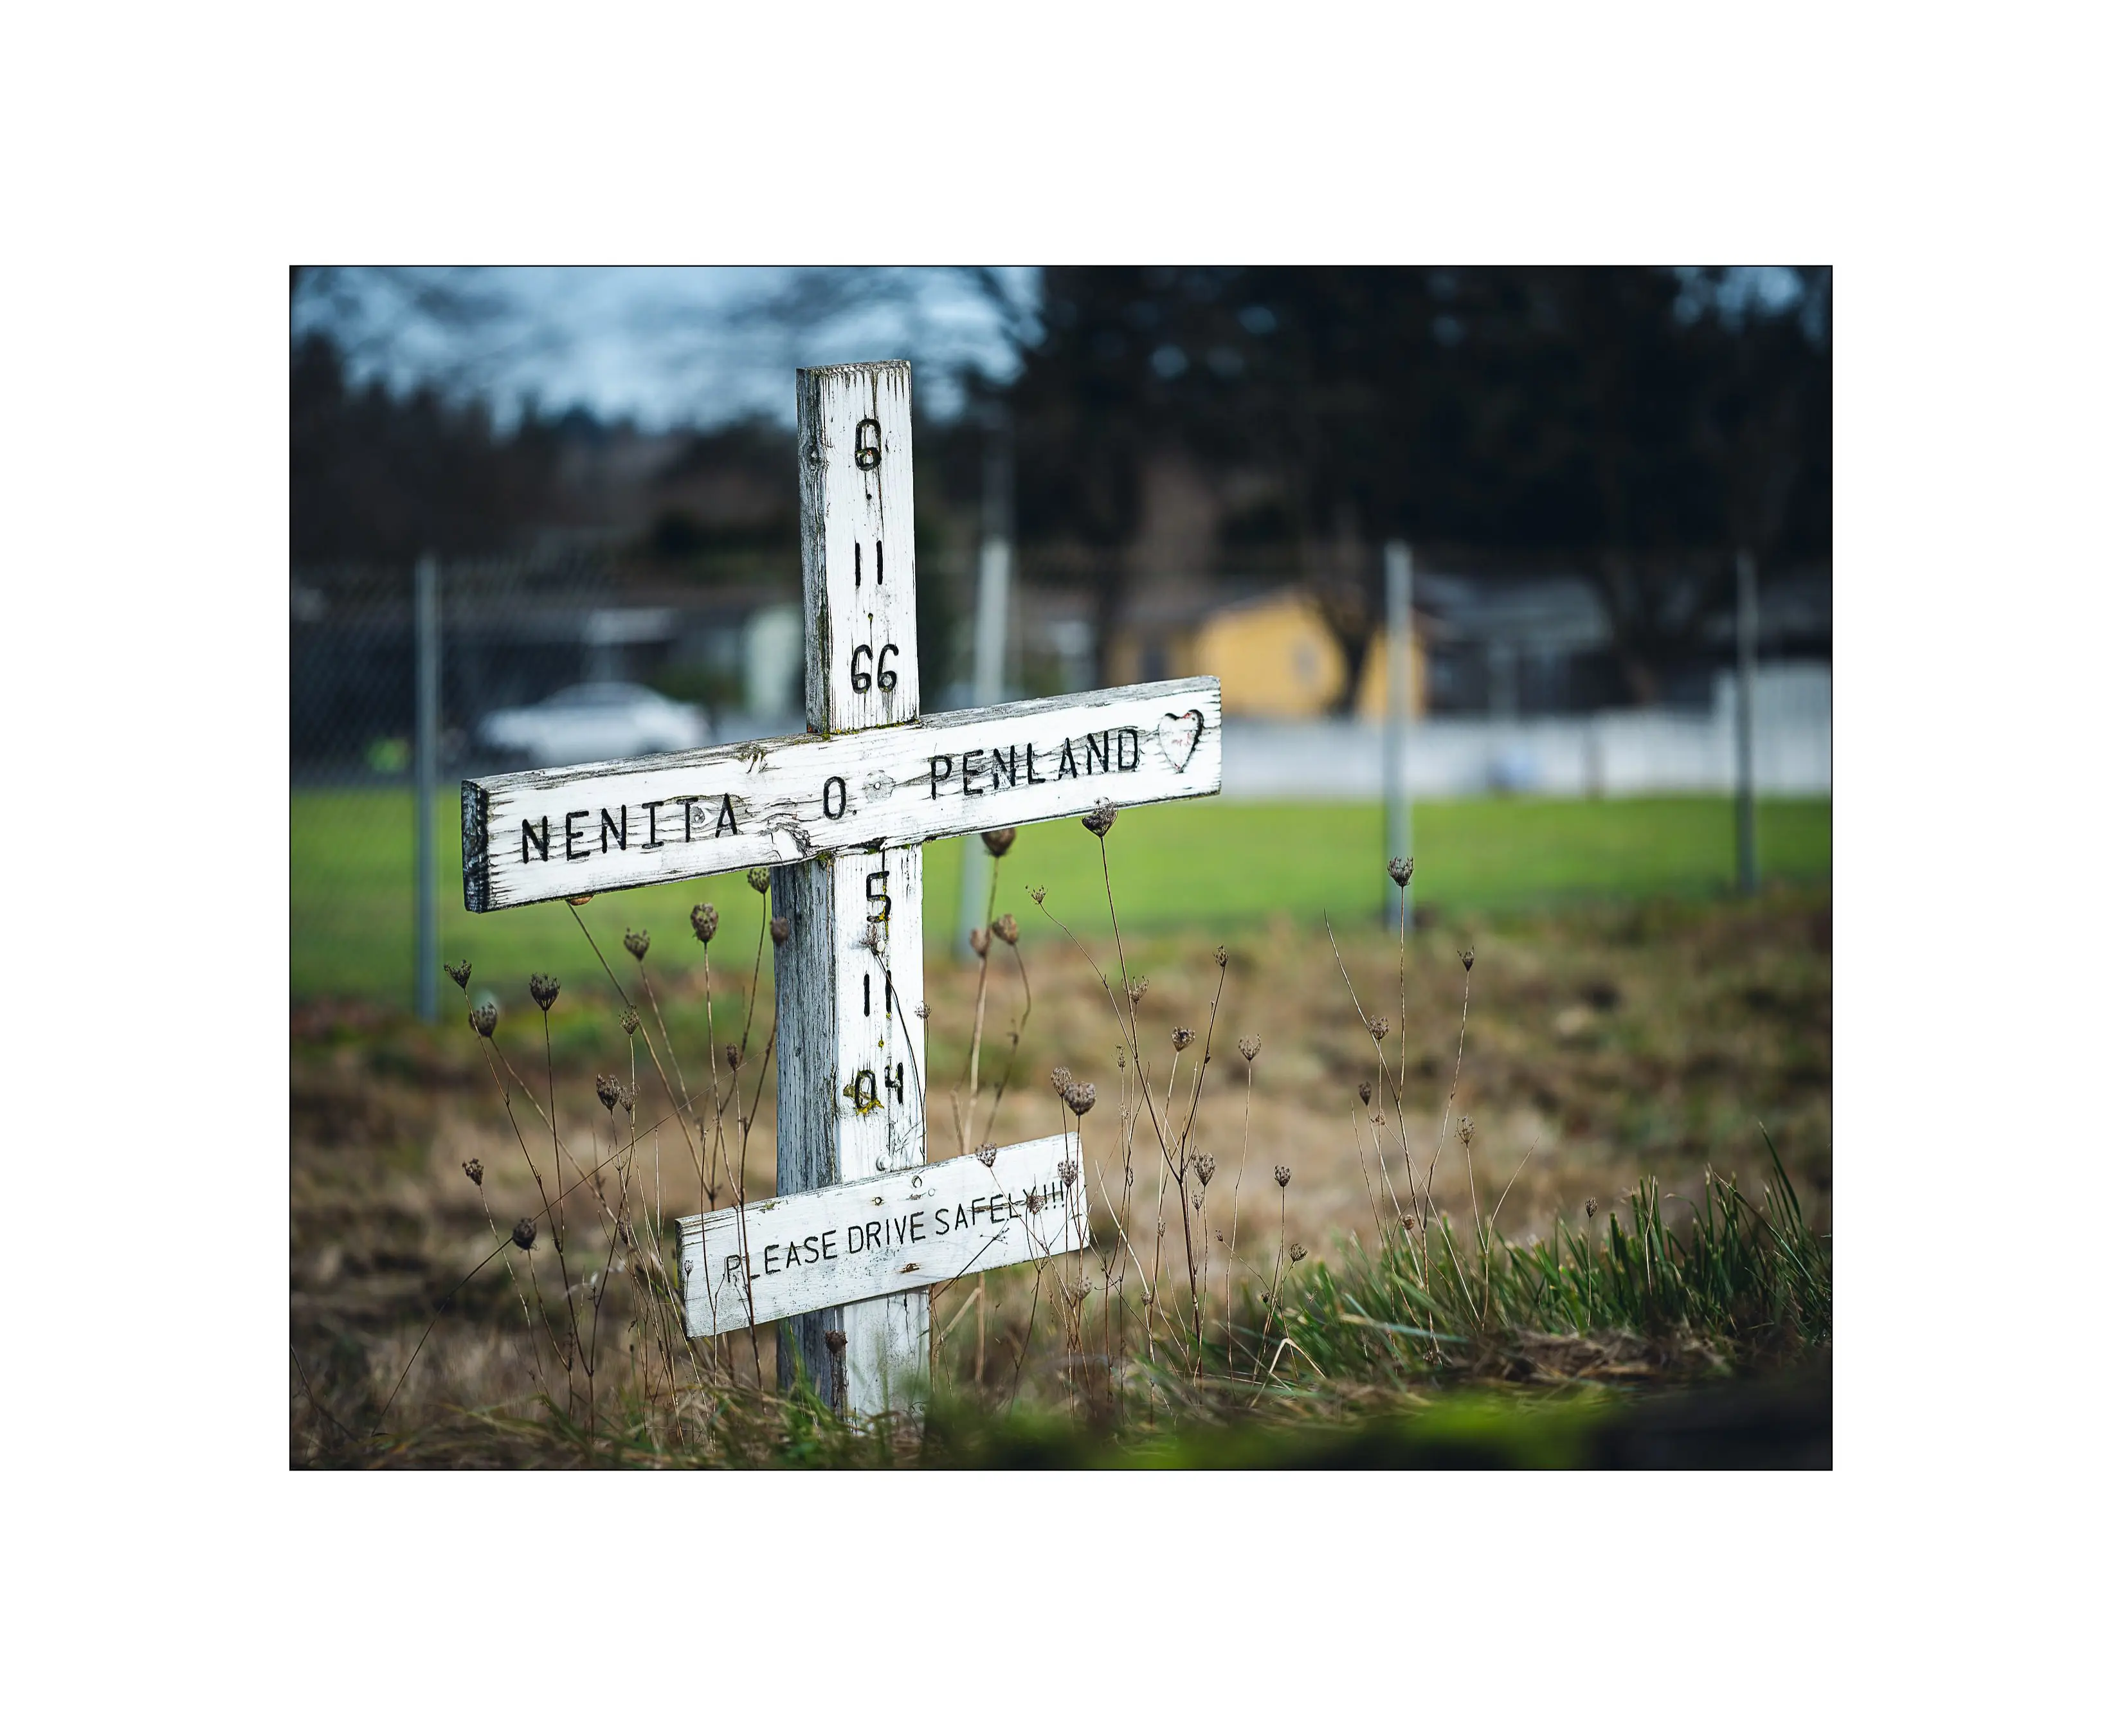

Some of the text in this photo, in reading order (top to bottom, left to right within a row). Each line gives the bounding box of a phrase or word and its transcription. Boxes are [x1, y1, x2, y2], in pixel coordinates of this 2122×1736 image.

[855, 540, 884, 586] 11
[851, 643, 899, 695] 66
[522, 793, 738, 864] NENITA
[930, 727, 1141, 800] PENLAND
[866, 870, 892, 923] 5
[864, 970, 892, 1017] 11
[854, 1062, 903, 1110] 04
[848, 1211, 927, 1254] DRIVE
